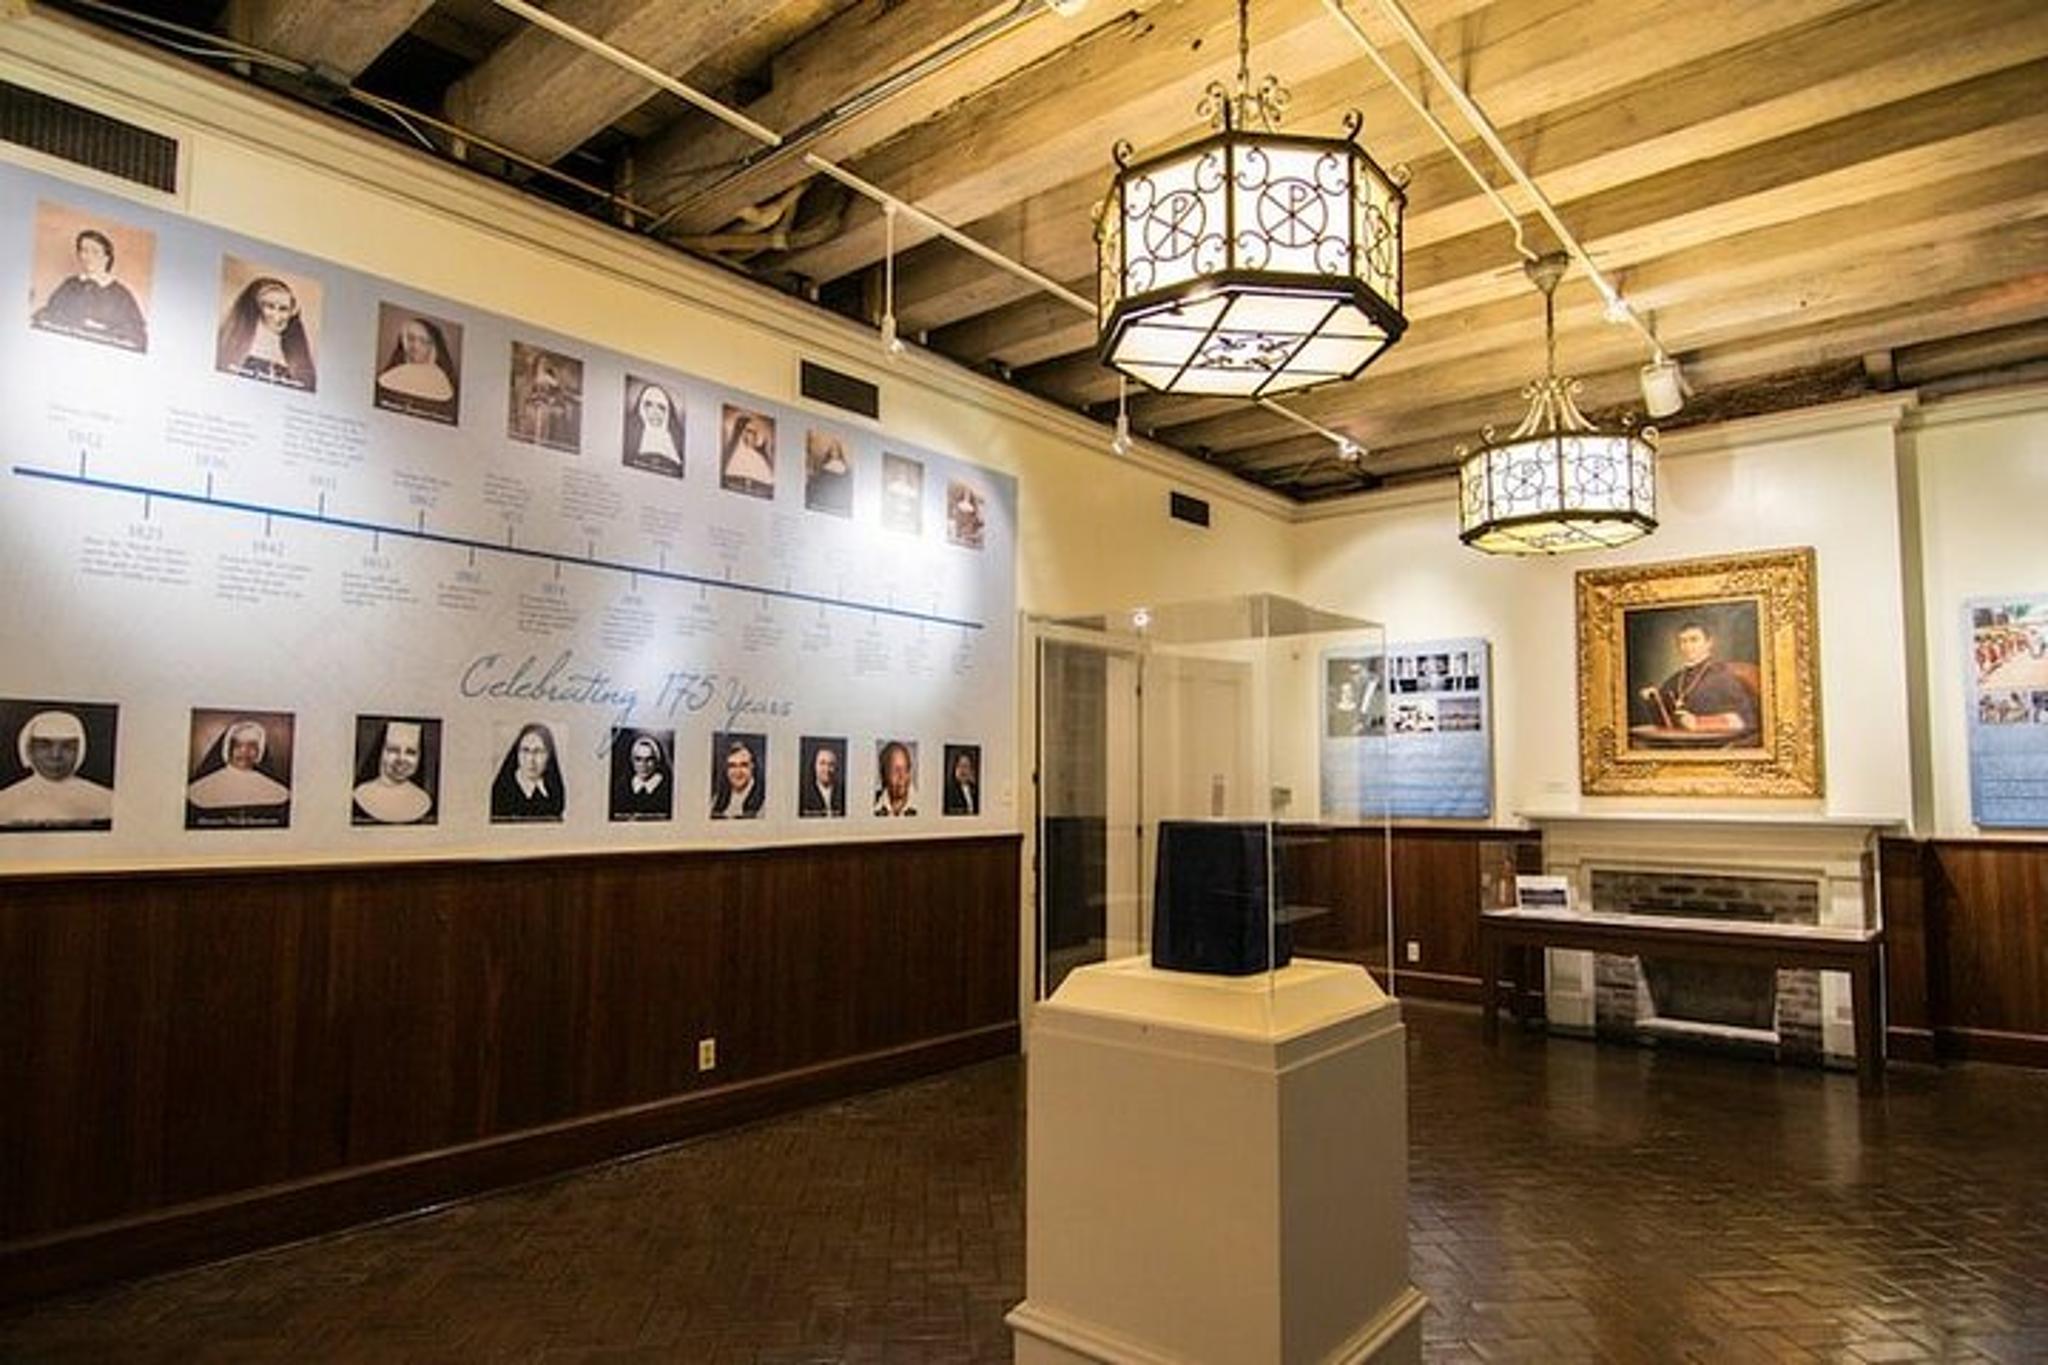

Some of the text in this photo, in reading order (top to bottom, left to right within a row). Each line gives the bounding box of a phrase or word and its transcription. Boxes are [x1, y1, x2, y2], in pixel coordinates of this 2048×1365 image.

[460, 650, 794, 760] Celebrating 175 Years
